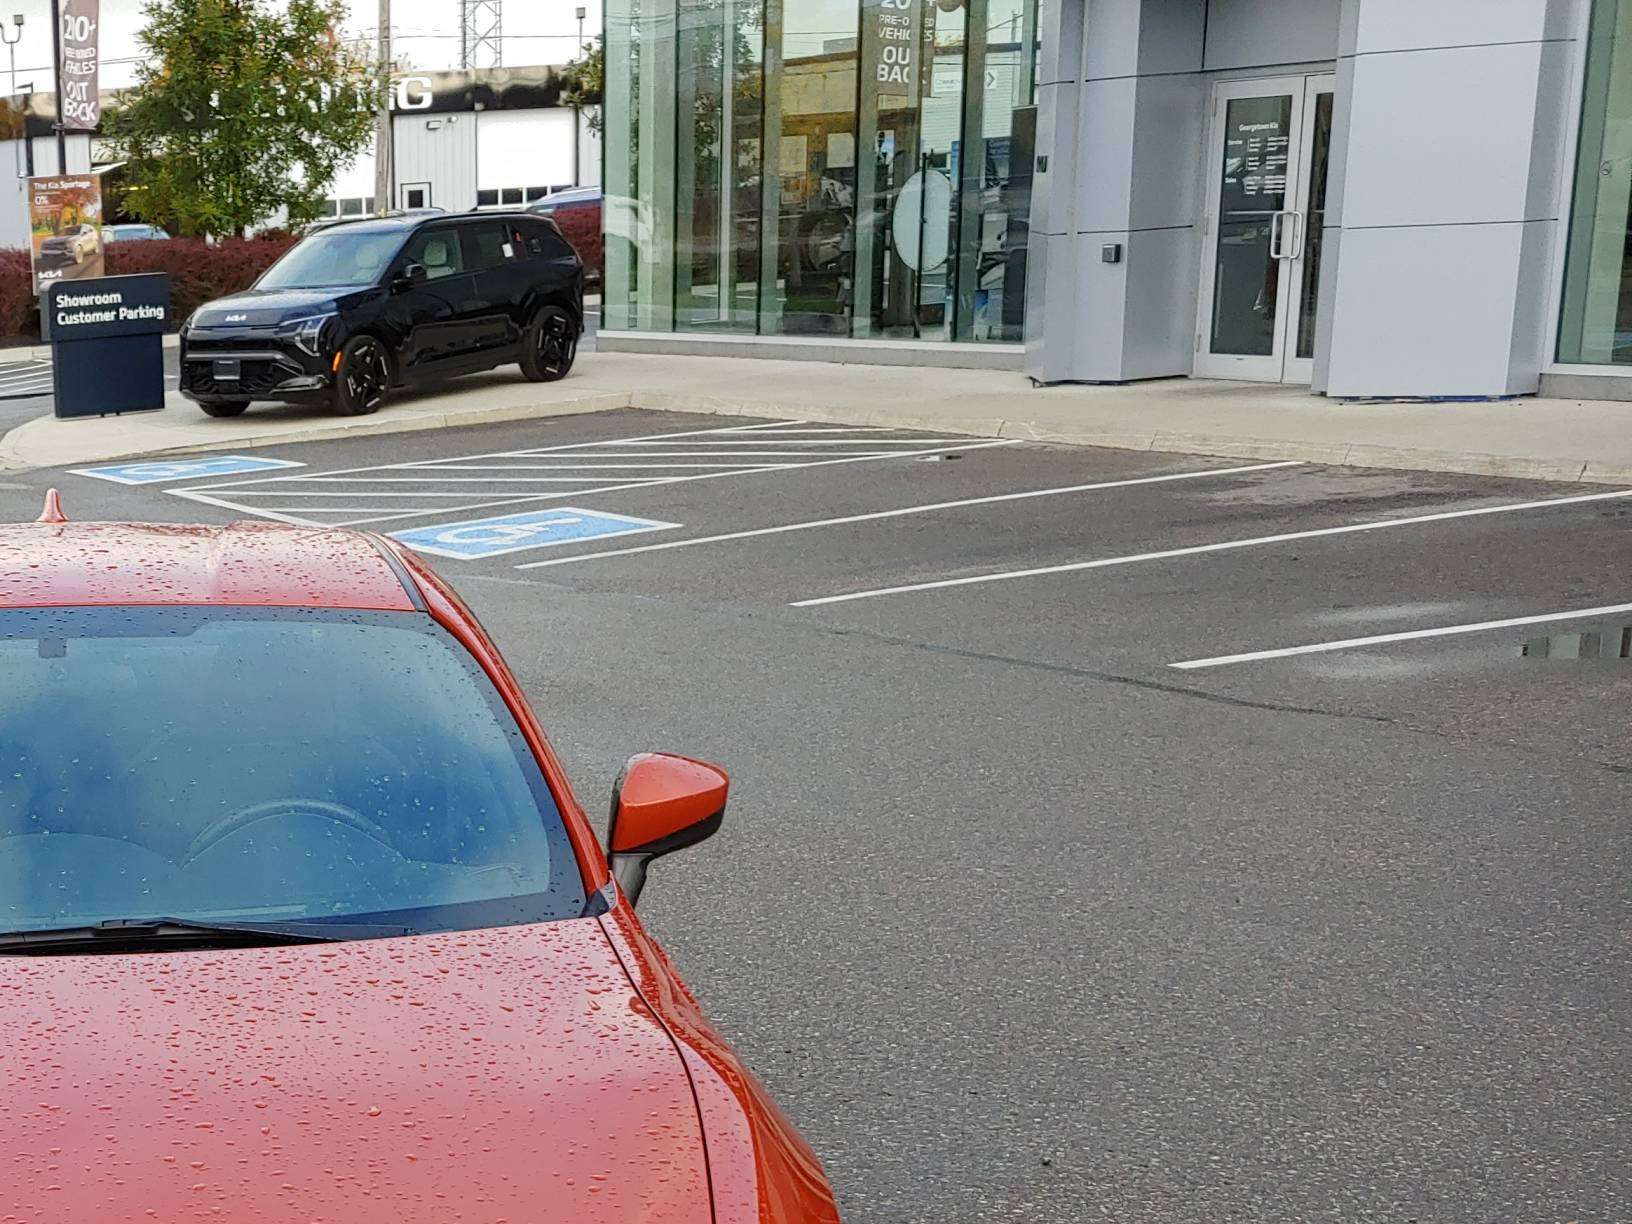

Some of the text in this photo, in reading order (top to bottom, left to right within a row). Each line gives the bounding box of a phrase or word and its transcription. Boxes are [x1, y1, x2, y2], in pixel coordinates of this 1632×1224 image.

[879, 14, 934, 27] PRE-OED
[879, 27, 933, 42] VEHICES
[883, 46, 910, 64] OU
[877, 64, 927, 84] BAC
[56, 293, 122, 308] Showroom
[57, 303, 165, 325] Customer Parking
